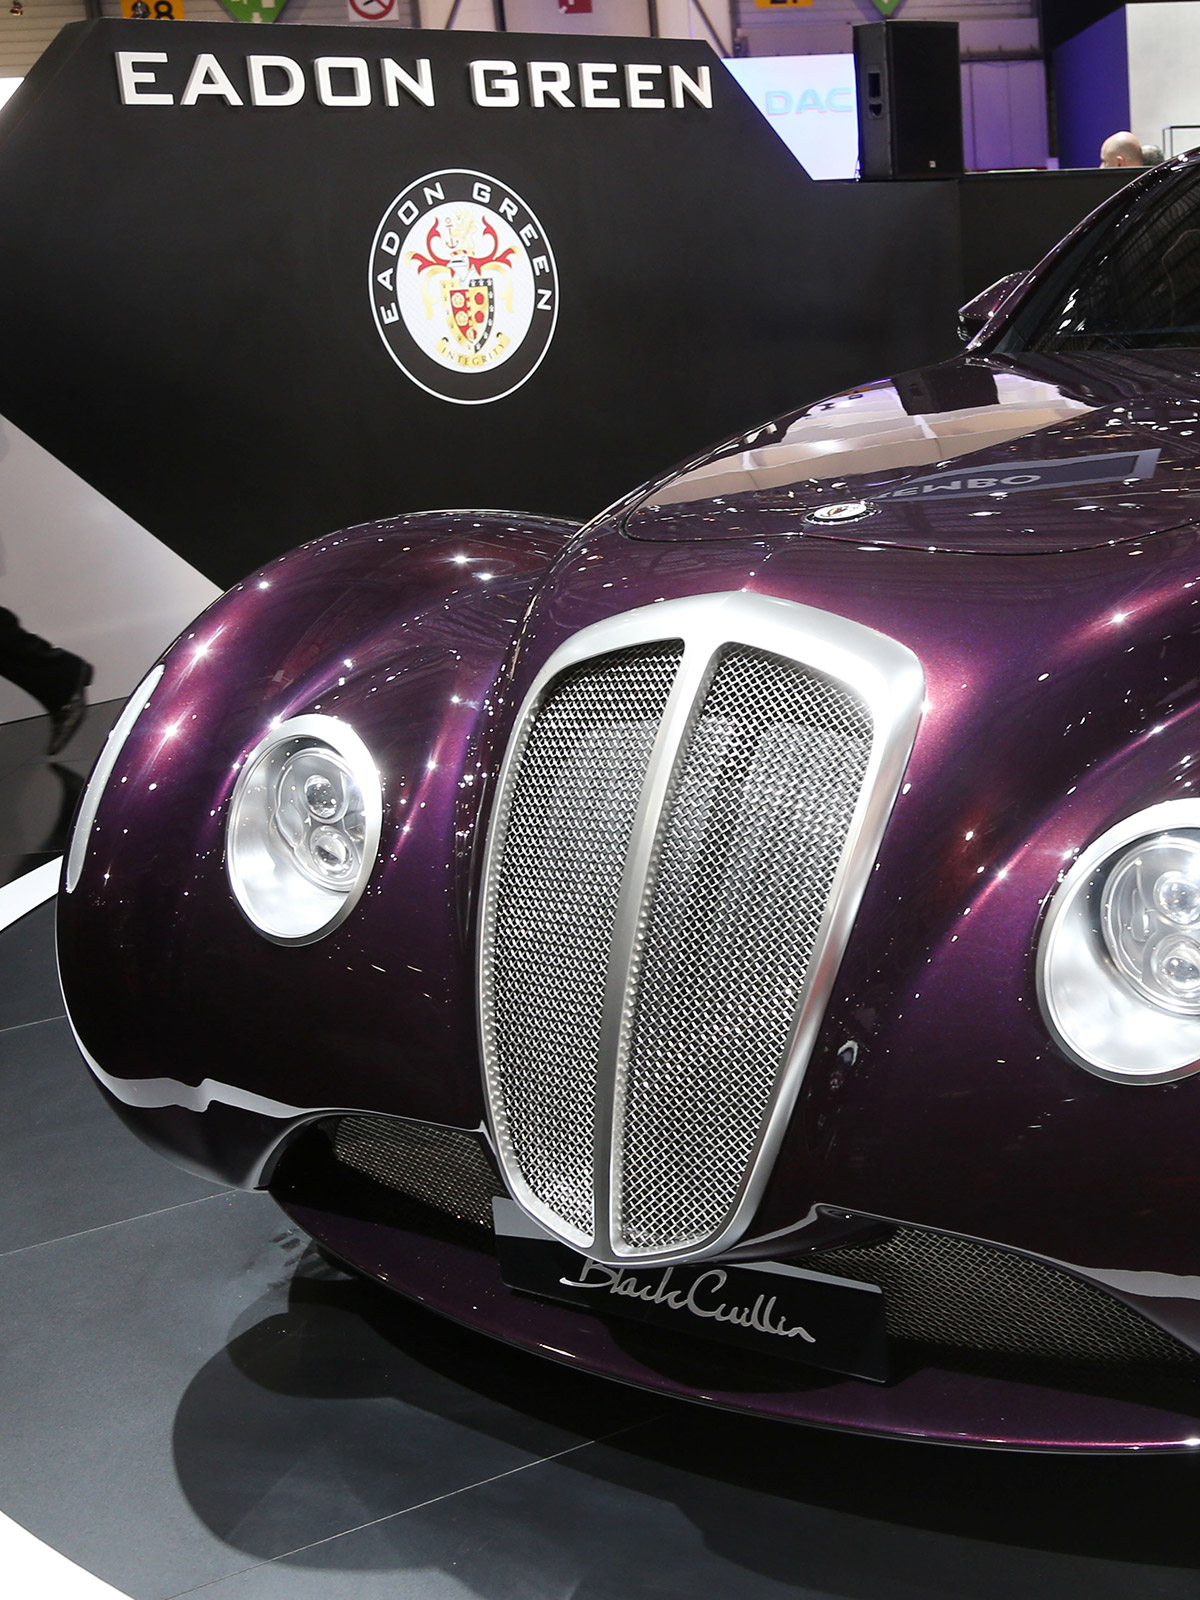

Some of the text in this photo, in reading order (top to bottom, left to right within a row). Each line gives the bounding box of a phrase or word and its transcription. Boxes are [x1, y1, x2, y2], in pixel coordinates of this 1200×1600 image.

[114, 50, 713, 110] EADON GREEN
[377, 182, 552, 324] EADON GREEN
[441, 342, 505, 366] INTEGRITY
